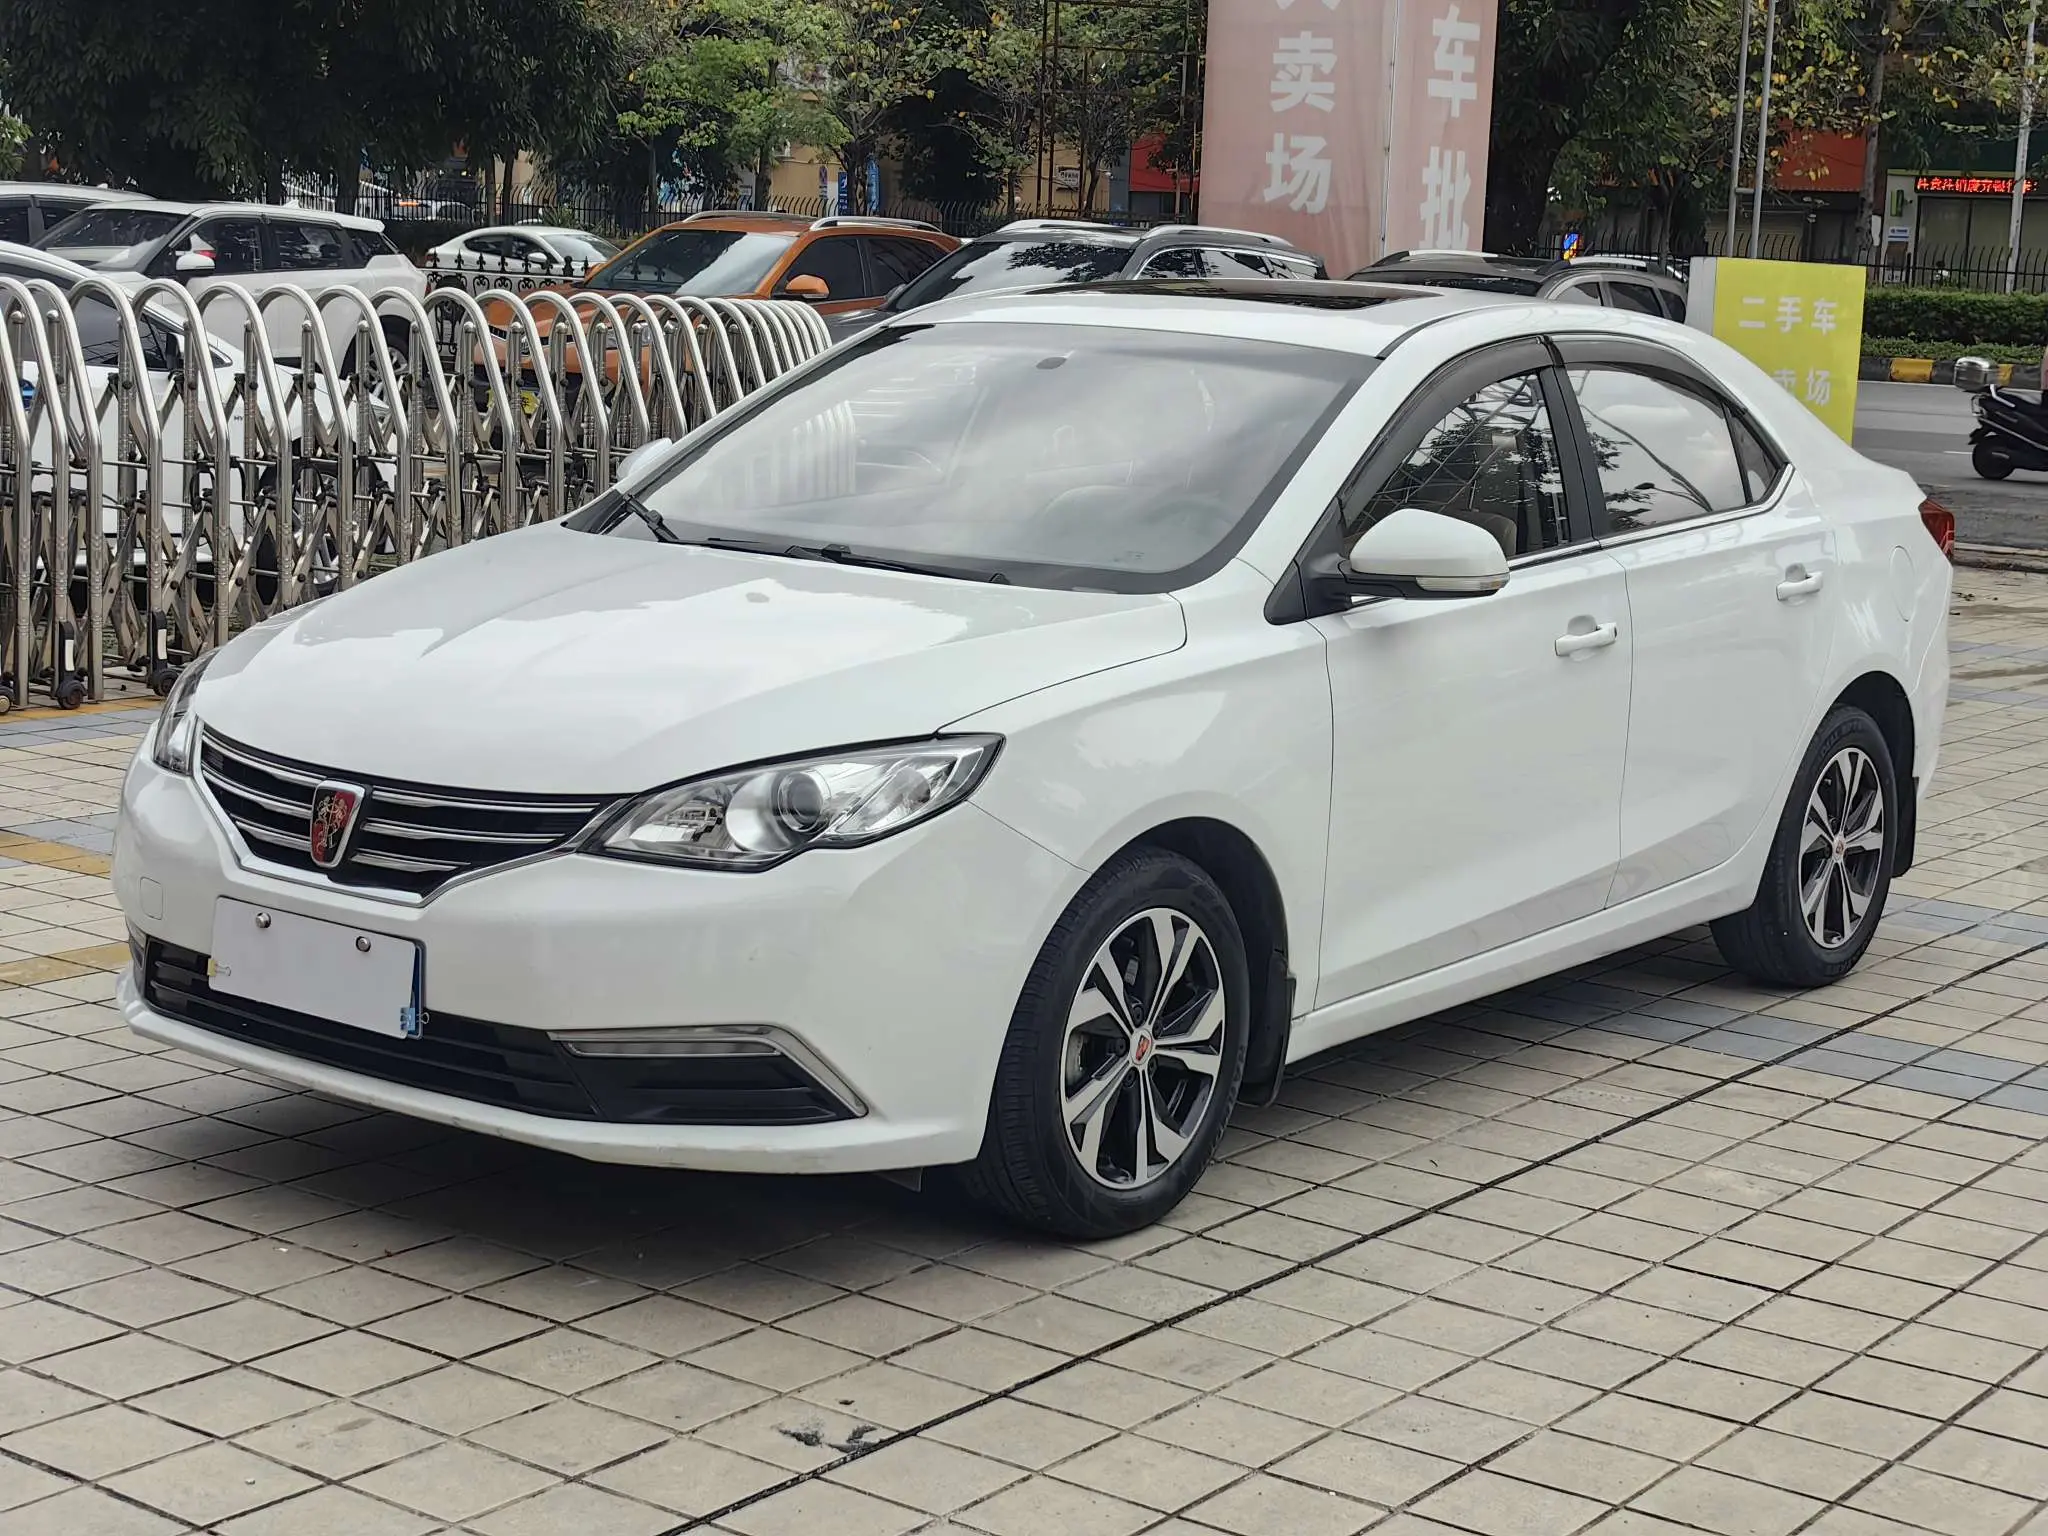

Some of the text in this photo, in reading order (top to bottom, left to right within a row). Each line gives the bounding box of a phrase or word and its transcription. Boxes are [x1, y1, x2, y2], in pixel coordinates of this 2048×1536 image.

[1264, 0, 1341, 214] 卖场
[1738, 296, 1839, 337] 二手车
